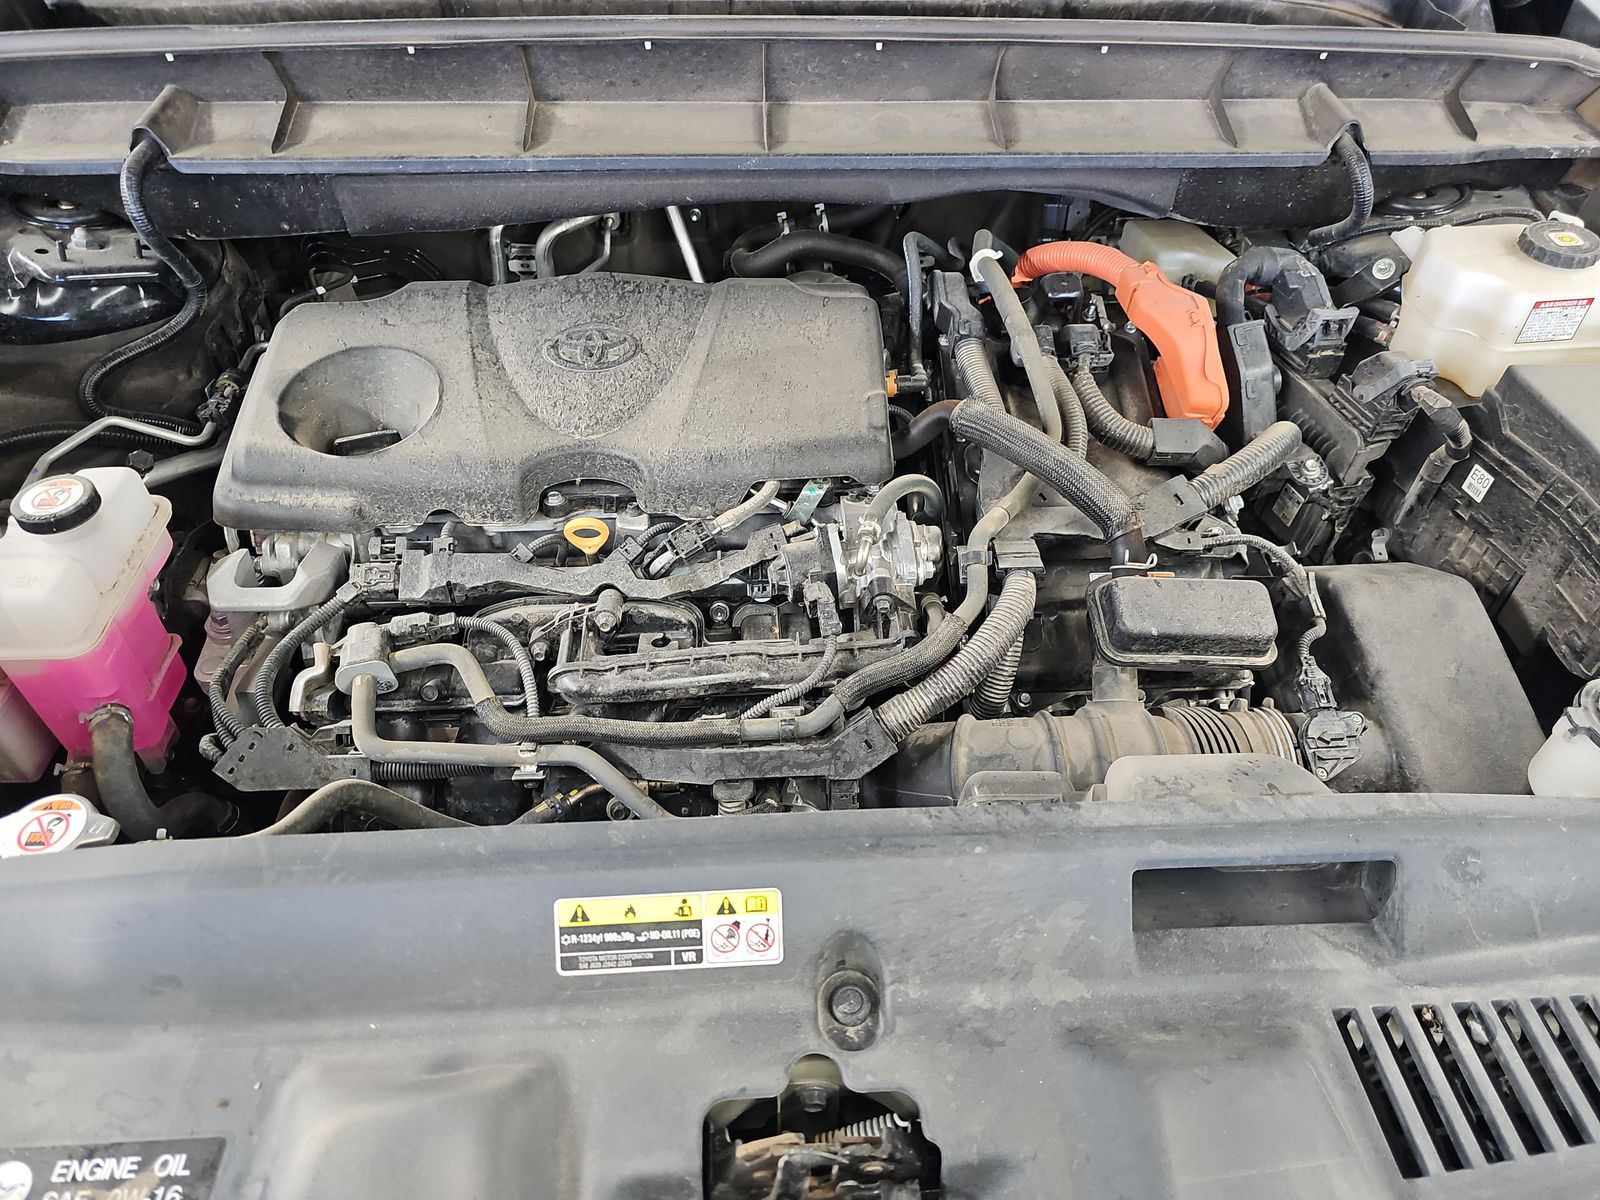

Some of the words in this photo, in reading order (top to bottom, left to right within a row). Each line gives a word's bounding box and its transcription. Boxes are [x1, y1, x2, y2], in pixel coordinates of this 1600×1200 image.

[1471, 468, 1490, 489] E80
[571, 933, 602, 945] R-1234yf
[681, 928, 700, 940] (POE)
[598, 954, 617, 962] MOTOR
[618, 953, 654, 961] CORPORATION
[681, 951, 697, 963] VR
[50, 1156, 142, 1183] ENGINE
[154, 1153, 191, 1177] OIL
